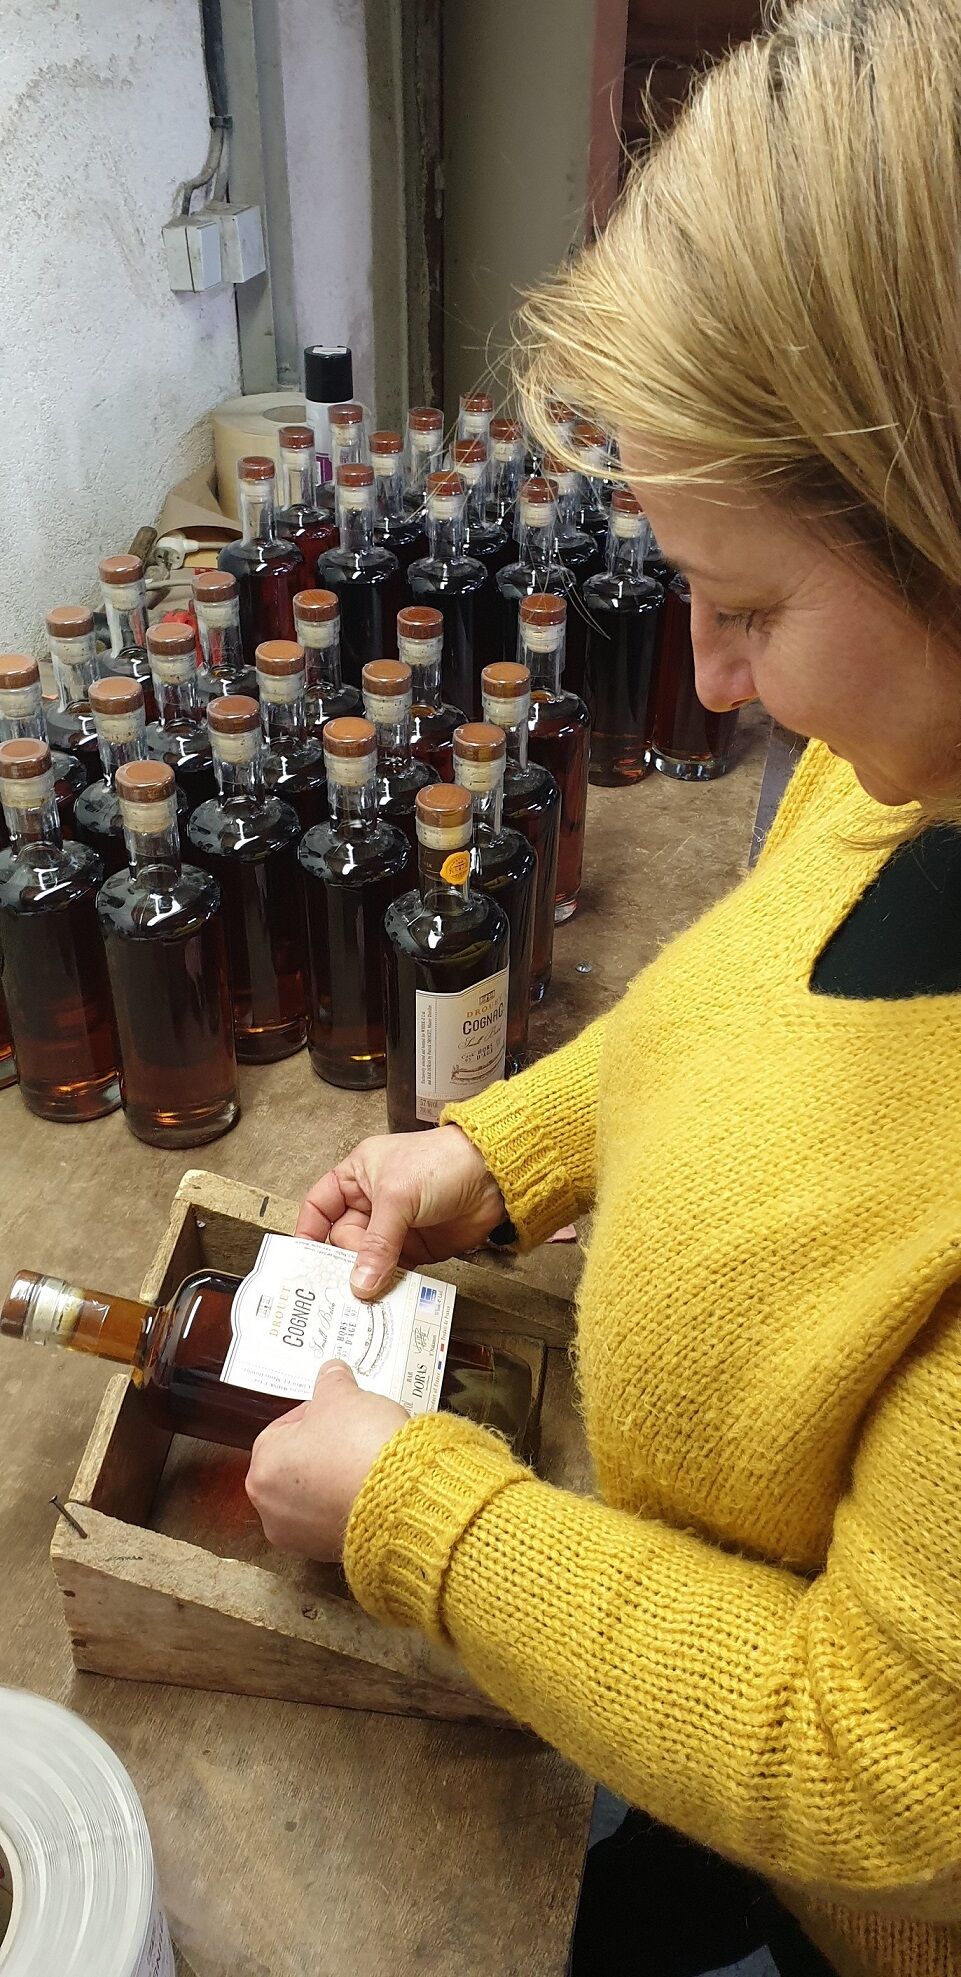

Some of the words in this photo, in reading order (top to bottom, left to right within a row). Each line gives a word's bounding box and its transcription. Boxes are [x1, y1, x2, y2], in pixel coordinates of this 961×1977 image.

[462, 1002, 504, 1035] COGNAC
[269, 1286, 291, 1337] DROUET
[282, 1288, 316, 1348] COGNAC
[318, 1287, 337, 1330] Batch
[309, 1328, 328, 1359] Small
[337, 1322, 348, 1342] HORS
[345, 1323, 357, 1345] D'AGE
[412, 1363, 428, 1399] DORAS
